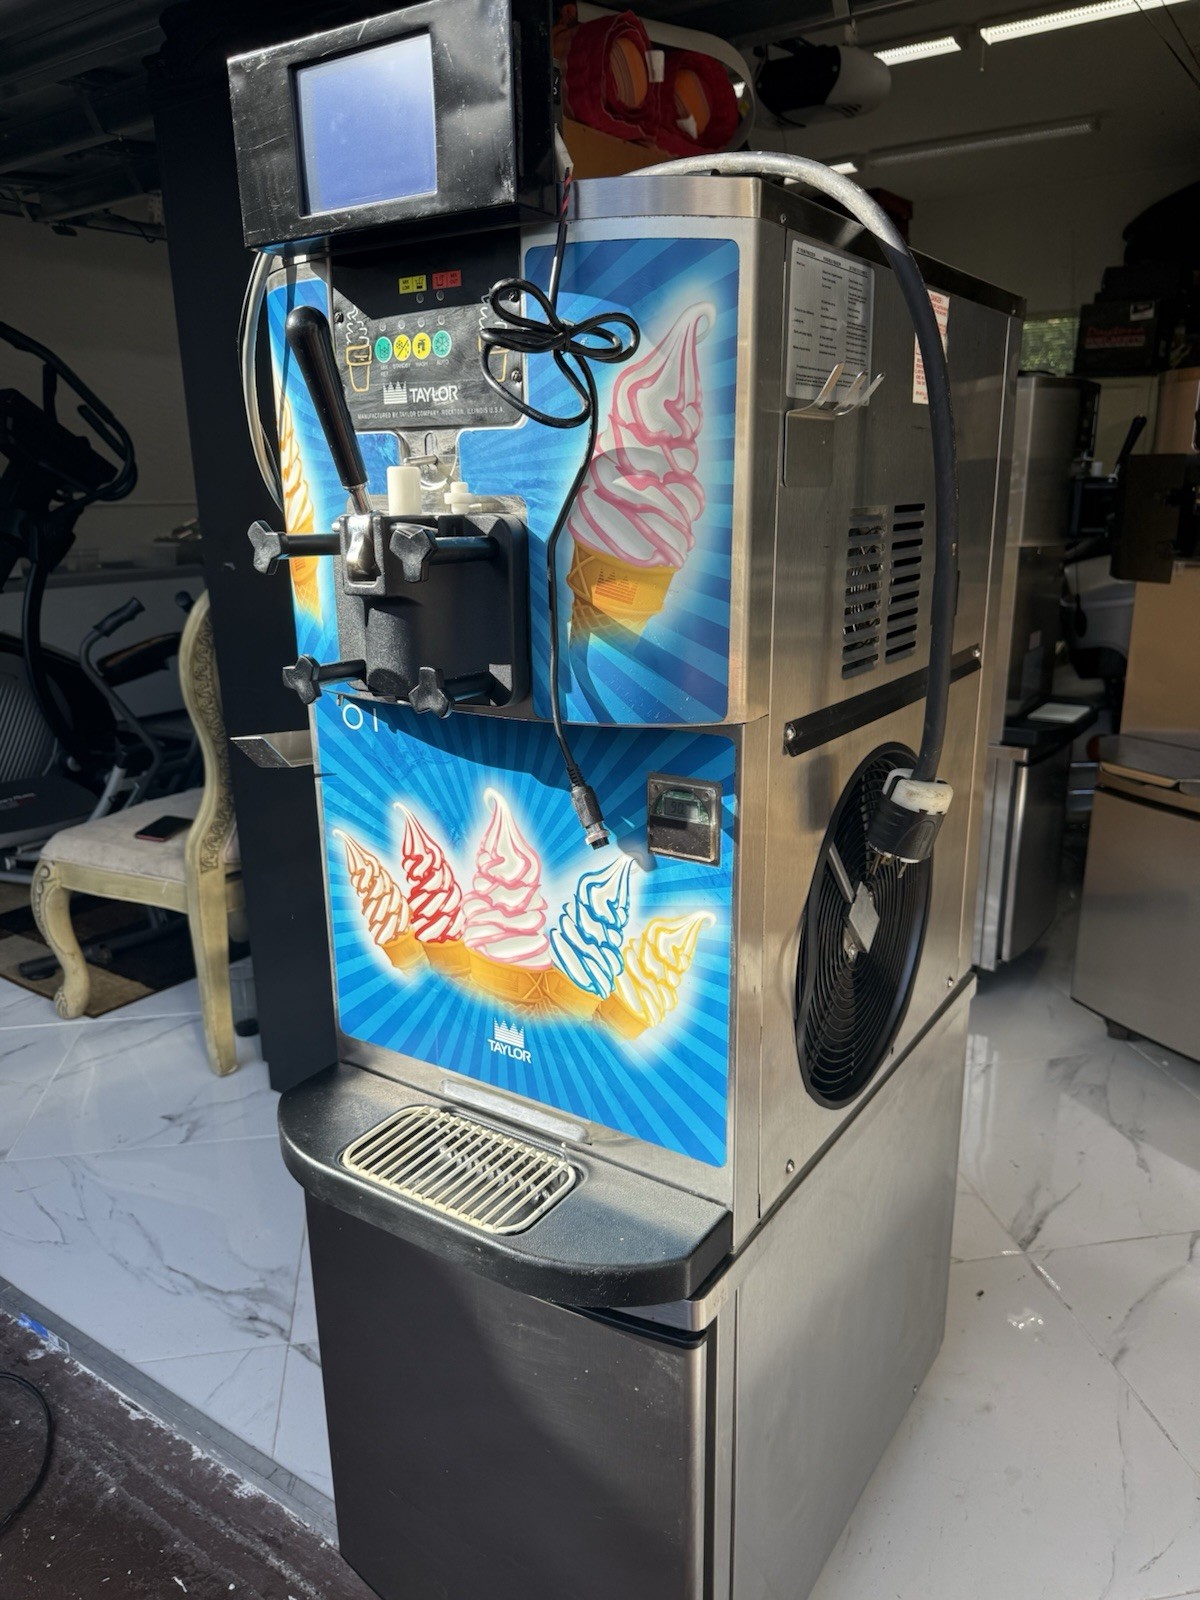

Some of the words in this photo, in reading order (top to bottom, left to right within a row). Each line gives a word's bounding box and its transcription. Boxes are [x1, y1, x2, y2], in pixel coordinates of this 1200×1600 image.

[409, 385, 459, 403] TAYLOR
[357, 411, 392, 419] MANUFACTURED
[399, 410, 416, 418] TAYLOR
[487, 1038, 532, 1064] TAYLOR
